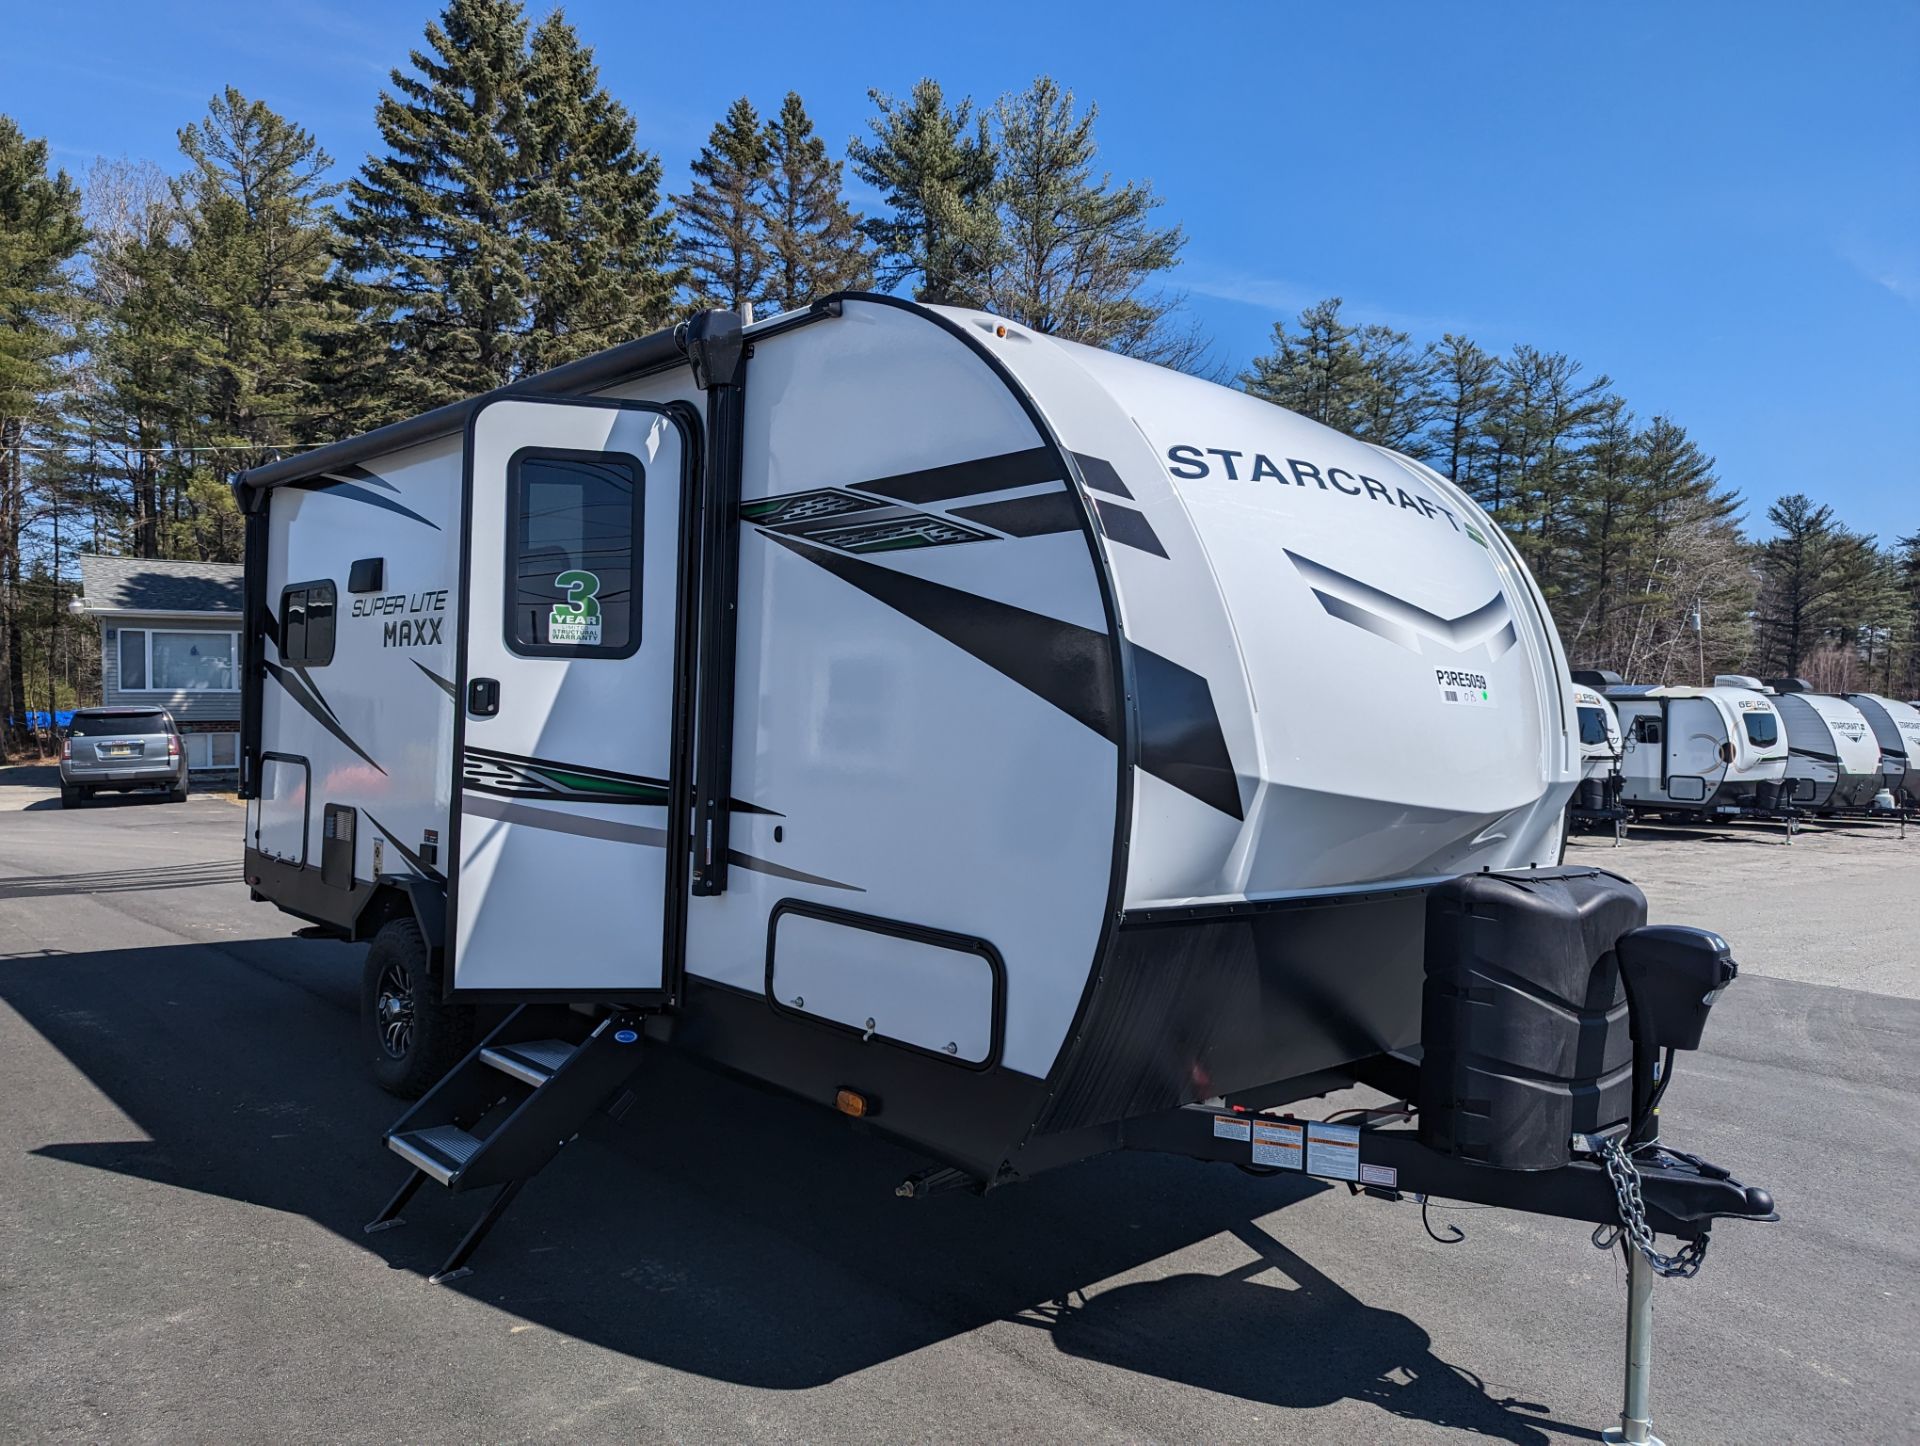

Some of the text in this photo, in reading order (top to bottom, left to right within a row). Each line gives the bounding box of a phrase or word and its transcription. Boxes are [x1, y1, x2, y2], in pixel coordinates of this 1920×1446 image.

[1167, 444, 1460, 532] STARCRAFT
[352, 589, 449, 617] SUPER LITE
[553, 569, 600, 616] 3
[383, 617, 443, 648] MAXX
[555, 614, 597, 624] YEAR
[1436, 669, 1487, 690] P3RE5059
